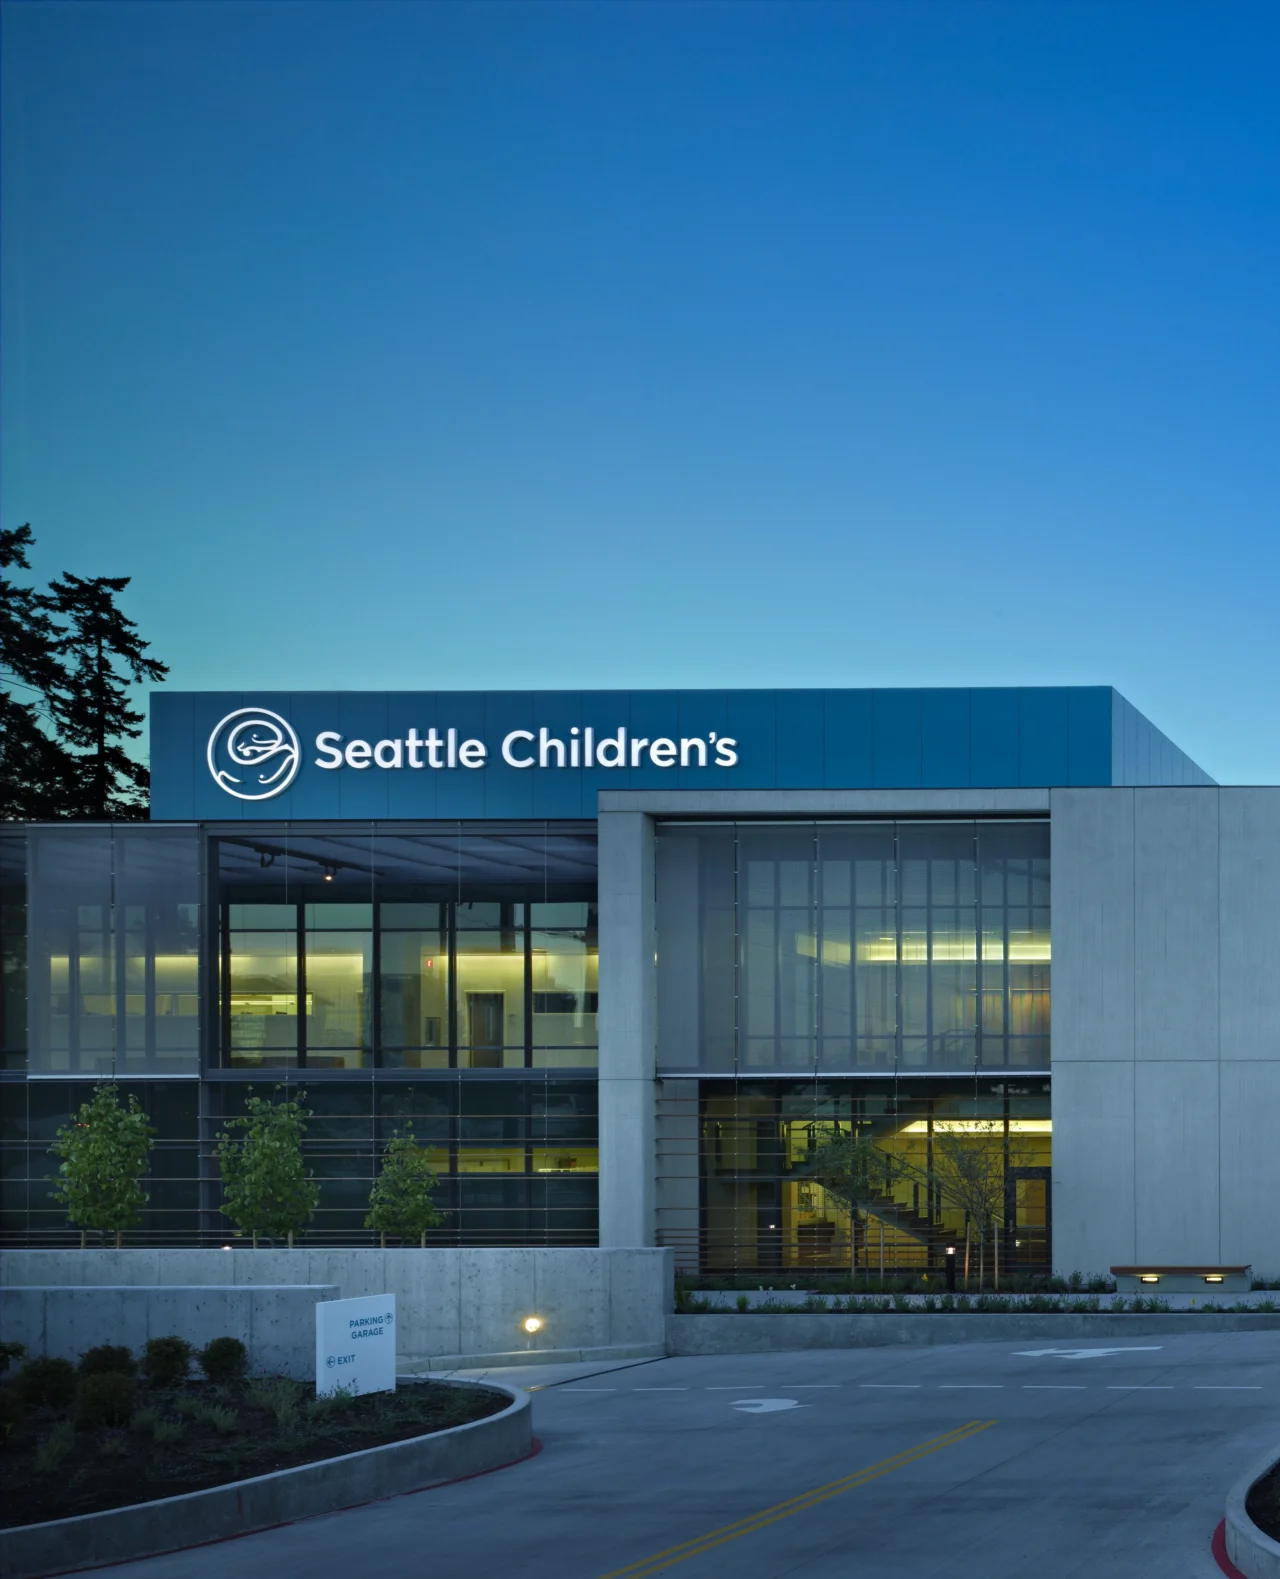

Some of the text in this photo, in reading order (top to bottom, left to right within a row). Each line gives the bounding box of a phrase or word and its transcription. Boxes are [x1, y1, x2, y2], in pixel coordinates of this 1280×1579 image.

[314, 726, 739, 769] Seattle Children's
[349, 1316, 383, 1328] PARKING
[351, 1327, 383, 1339] GARAGE
[337, 1354, 356, 1365] EXIT
